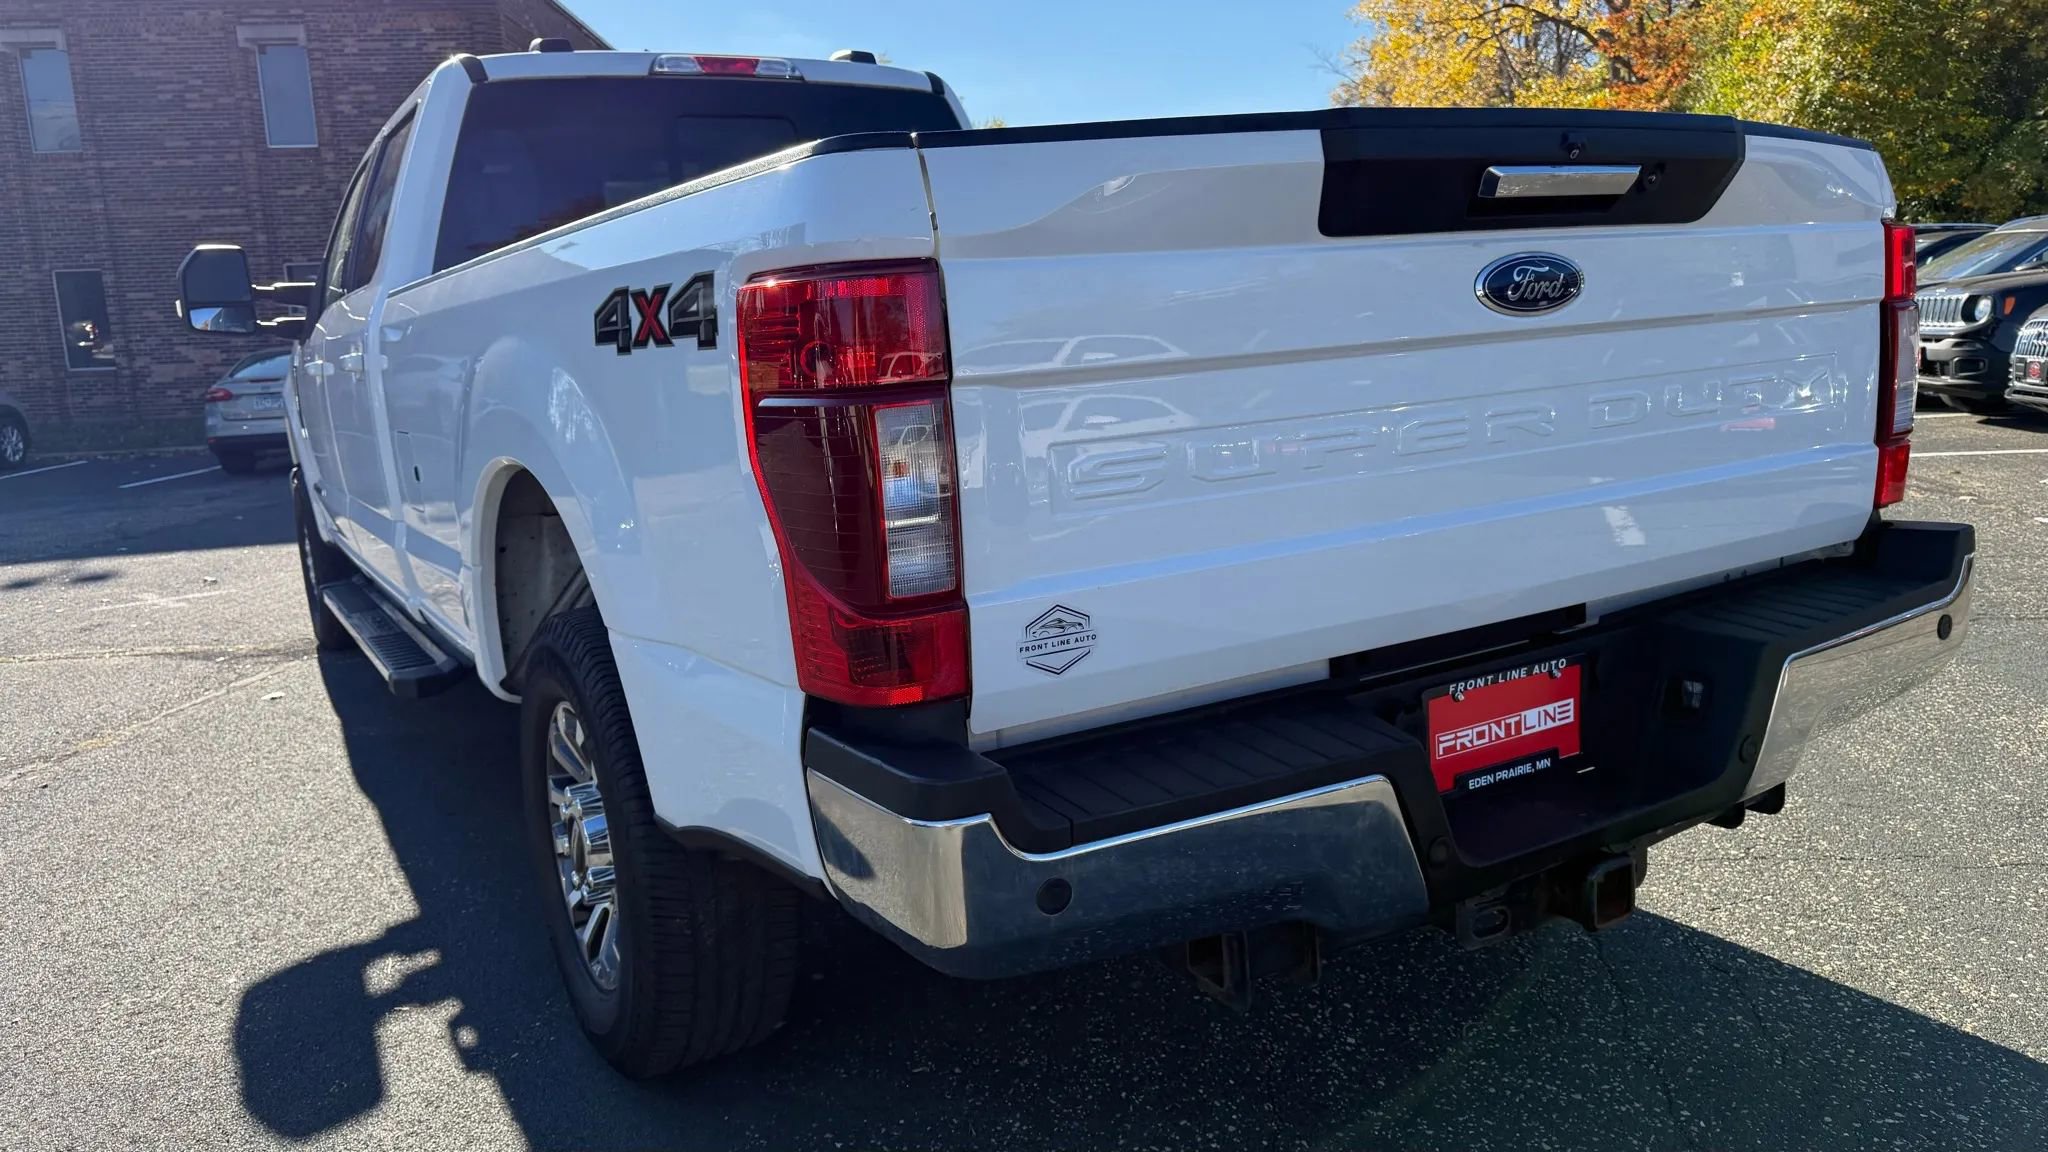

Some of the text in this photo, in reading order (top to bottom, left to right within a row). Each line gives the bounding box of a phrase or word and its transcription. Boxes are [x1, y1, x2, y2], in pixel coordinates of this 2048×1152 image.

[1507, 265, 1565, 302] Ford
[1067, 367, 1833, 500] SUPER DUTY
[1019, 633, 1097, 654] FRONT LINE AUTO
[1448, 658, 1567, 695] FRONT LINE AUTO
[1468, 757, 1552, 790] EDEN PRAIRIE, MN
